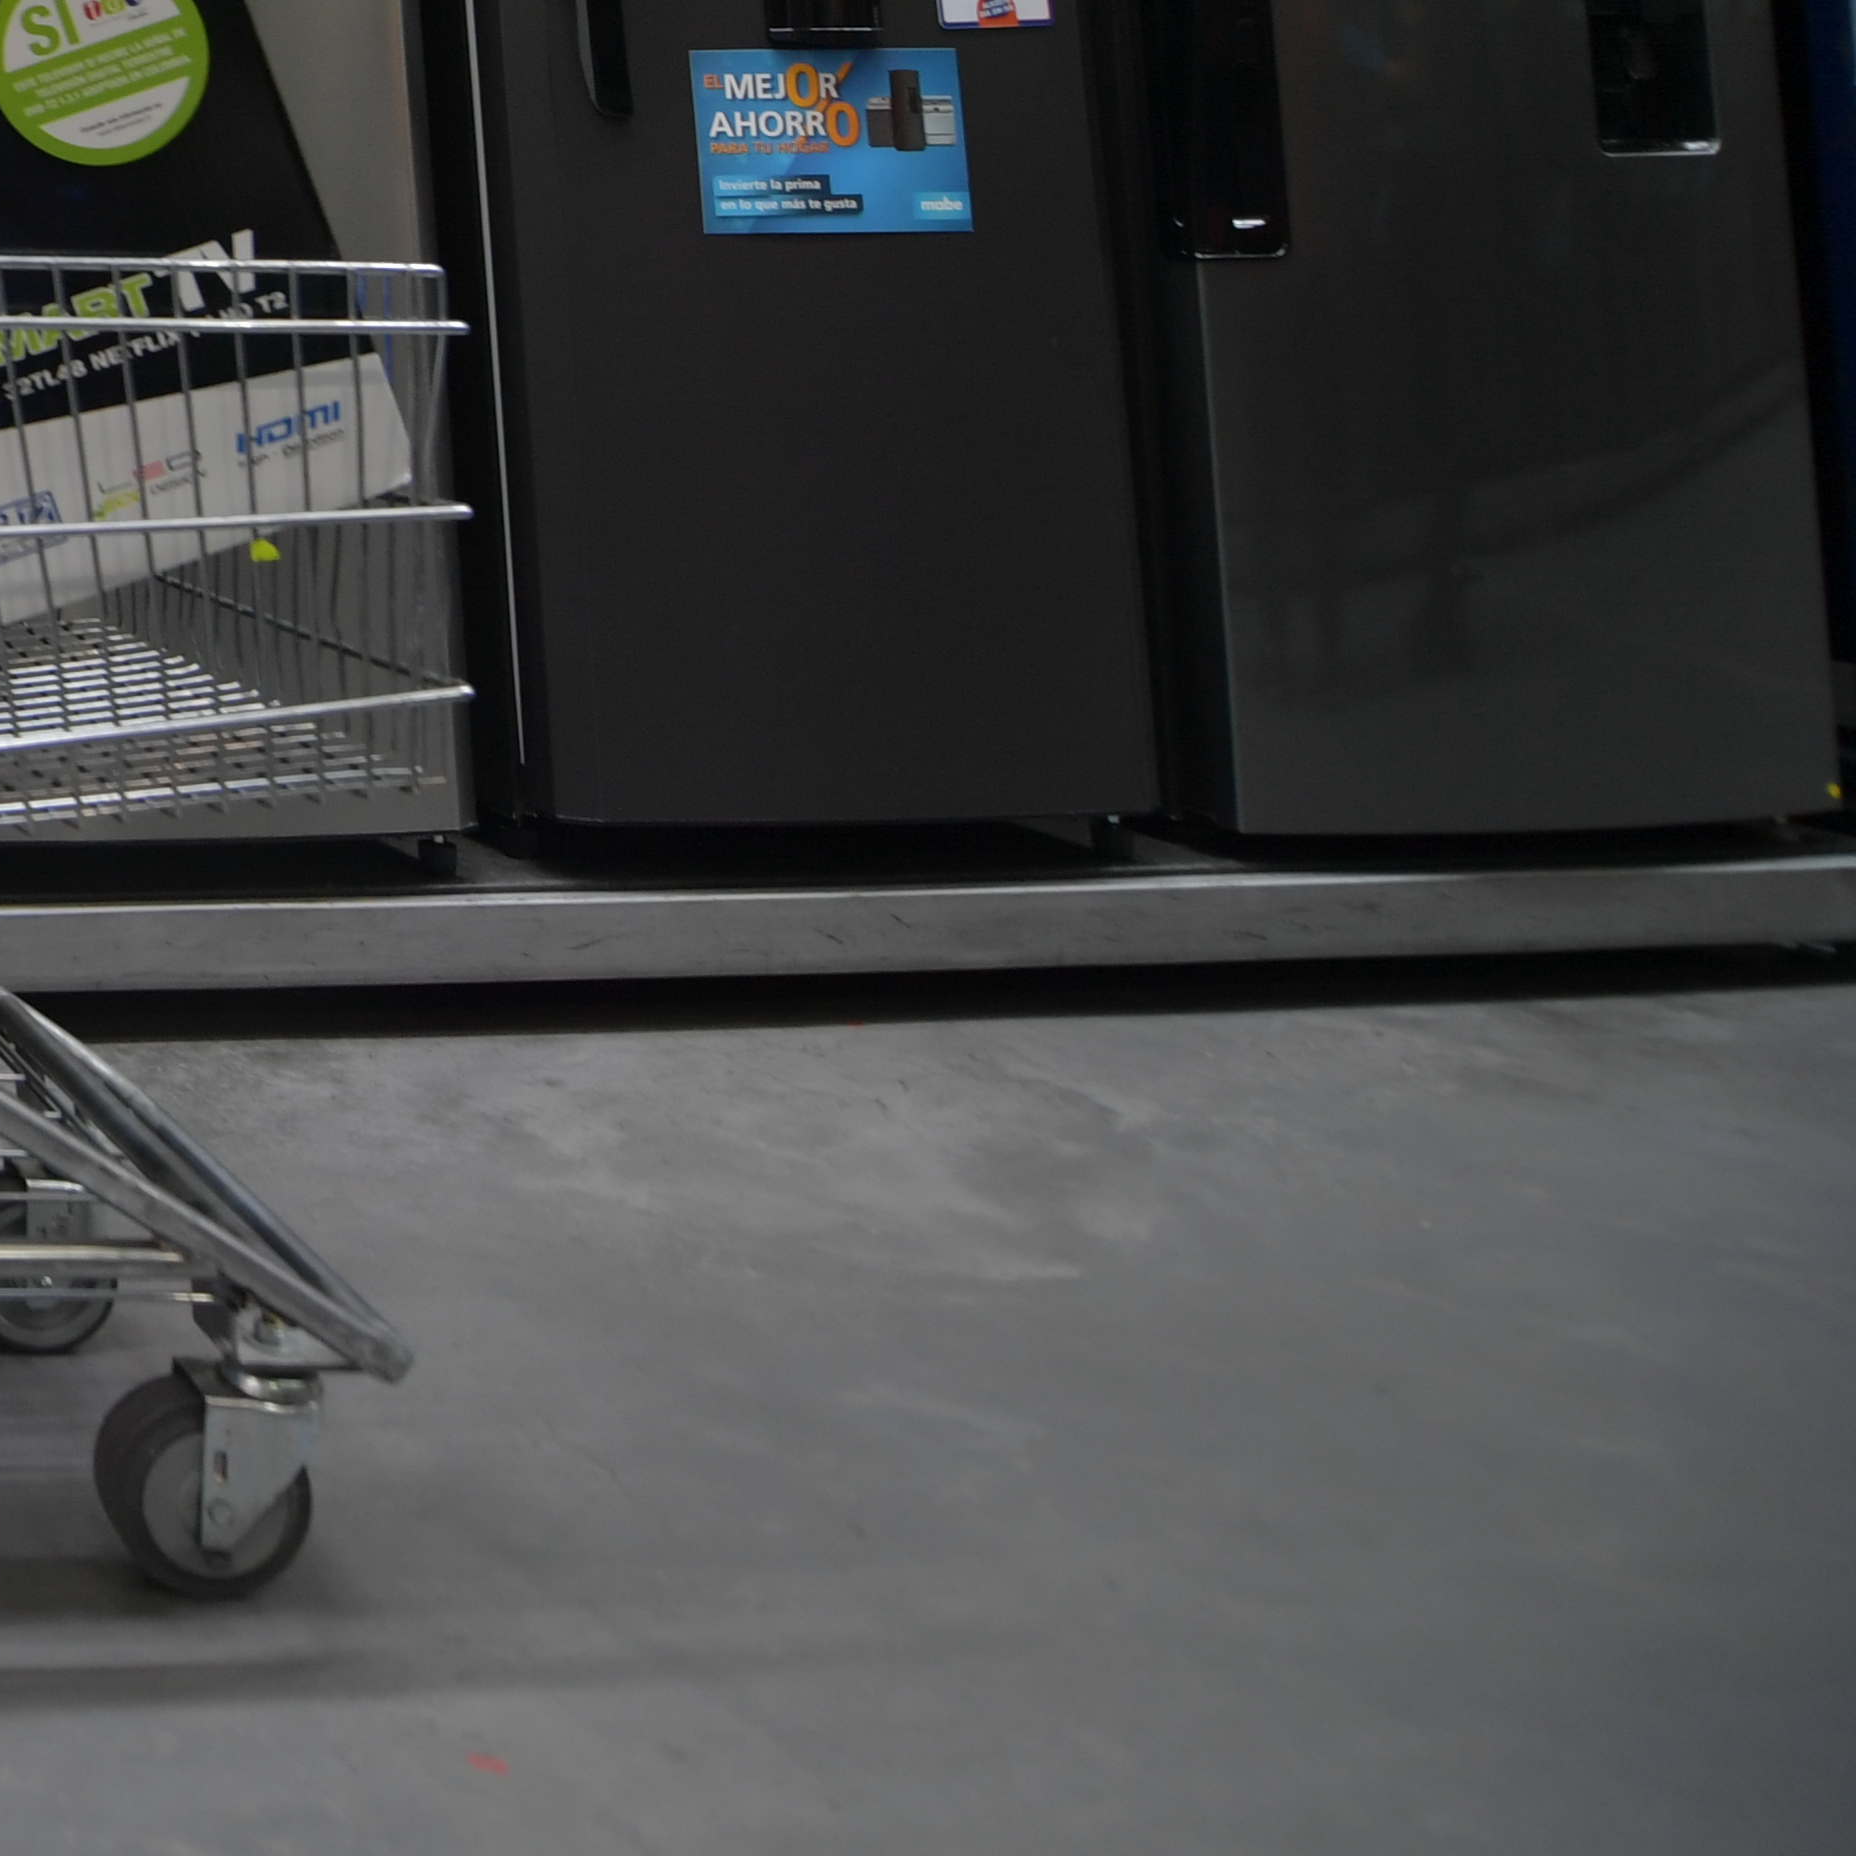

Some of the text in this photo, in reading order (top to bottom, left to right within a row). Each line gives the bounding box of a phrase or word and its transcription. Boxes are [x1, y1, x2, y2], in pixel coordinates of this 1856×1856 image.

[703, 73, 724, 90] EL
[709, 103, 860, 148] AHORRO
[719, 178, 821, 194] Invierte la prima
[720, 196, 858, 213] en lo que más te gusta
[920, 197, 963, 212] mabe
[153, 229, 256, 312] TV
[235, 400, 341, 456] HDMI
